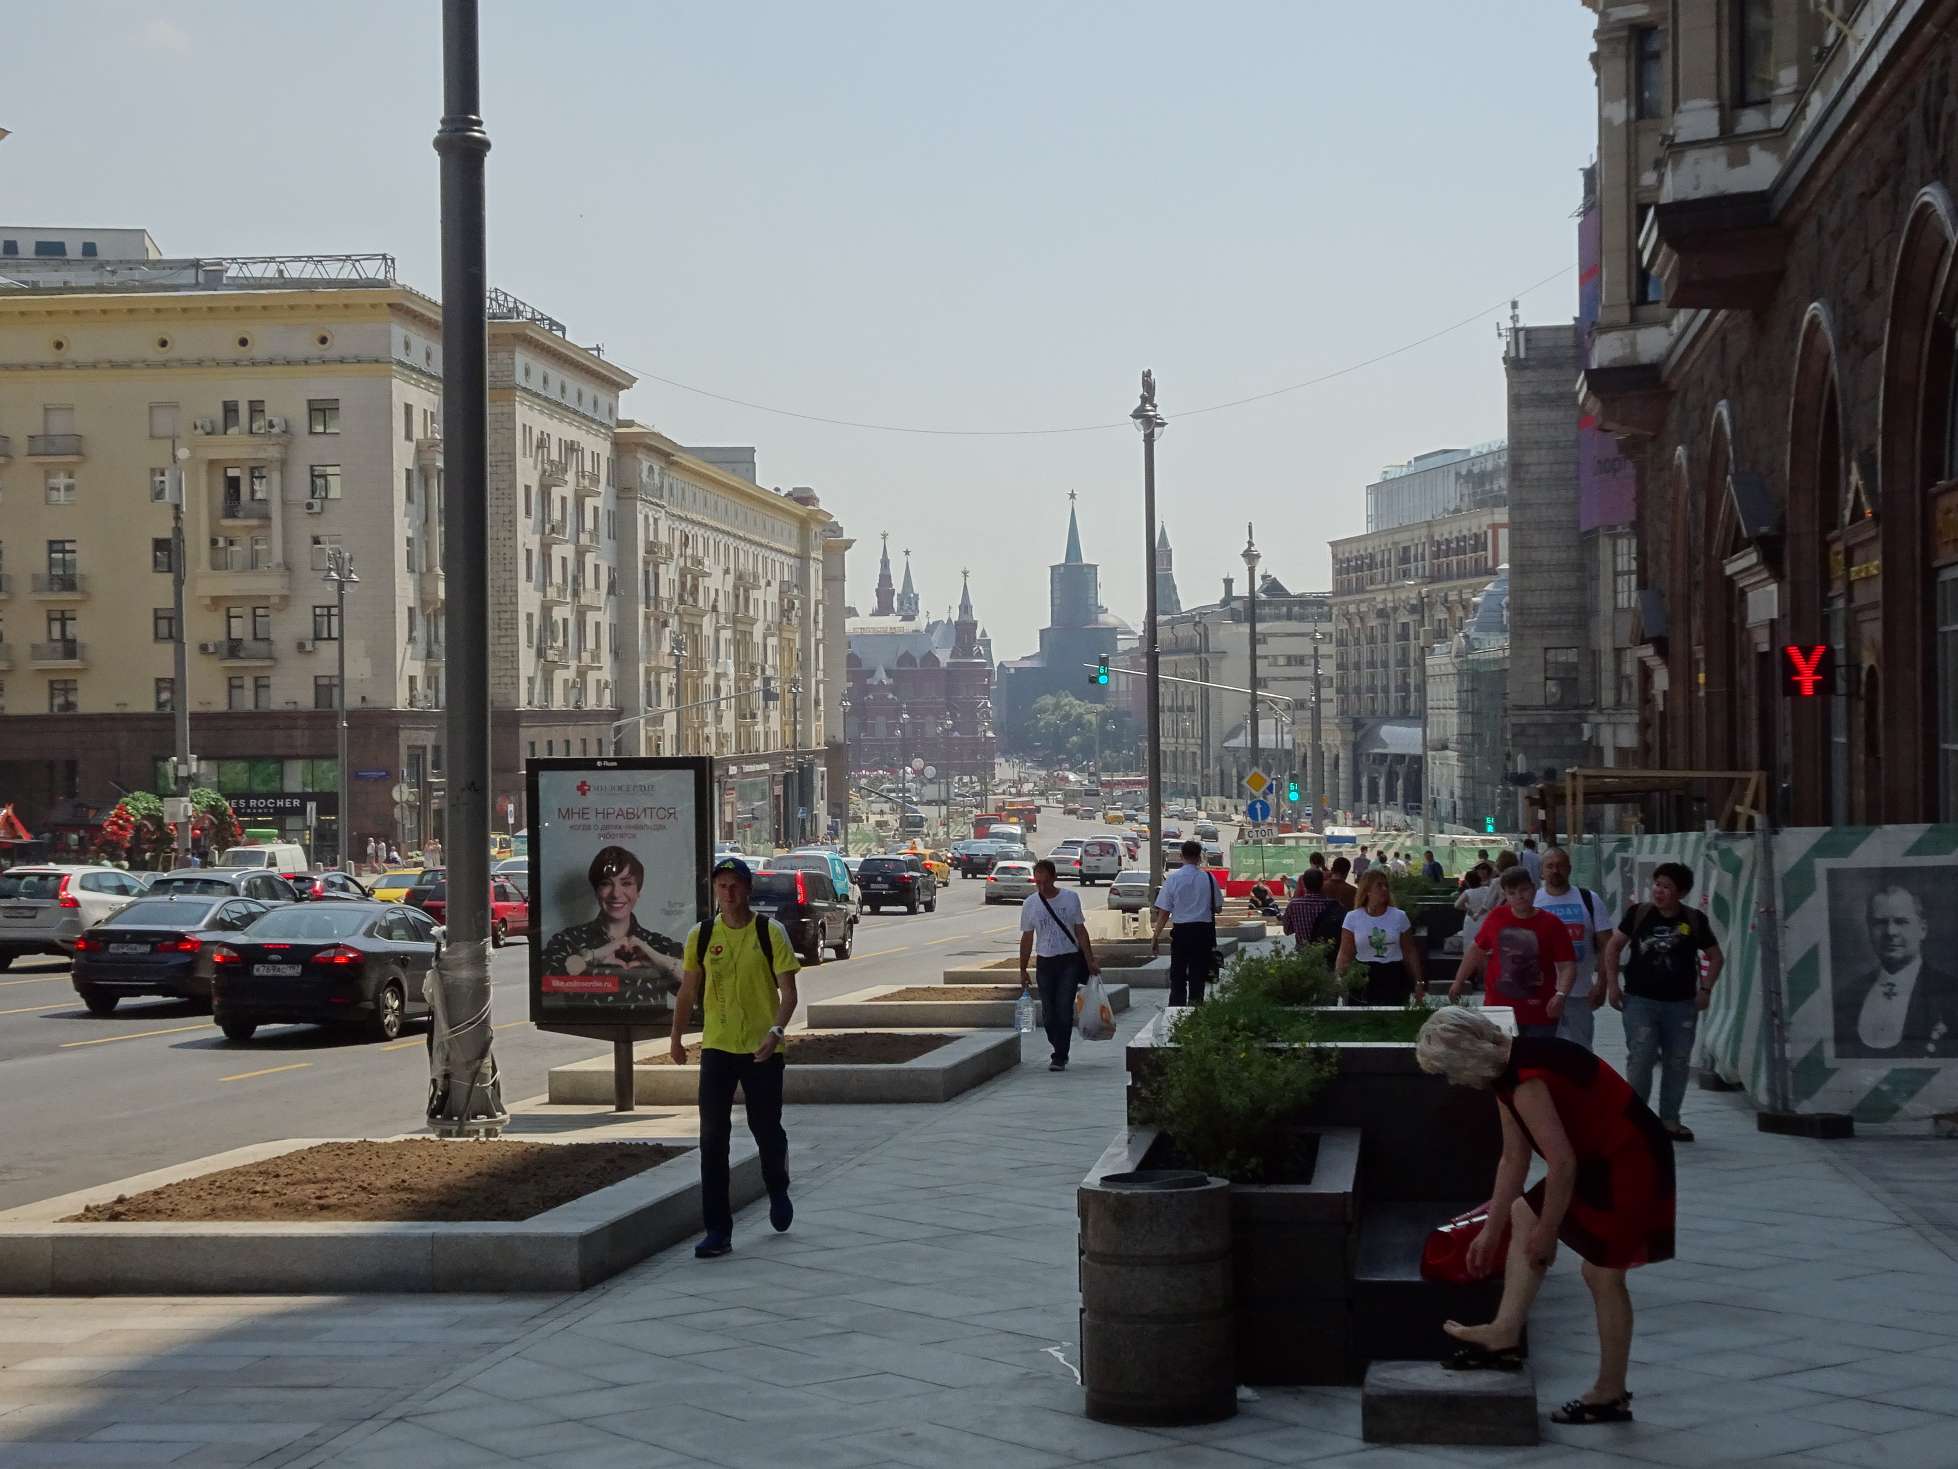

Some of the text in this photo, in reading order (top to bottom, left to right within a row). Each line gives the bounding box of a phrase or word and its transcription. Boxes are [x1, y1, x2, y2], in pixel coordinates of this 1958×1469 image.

[249, 798, 301, 808] ROCHER
[557, 806, 679, 823] МНЕ НРАВИТСЯ,
[1247, 828, 1274, 839] СТОП
